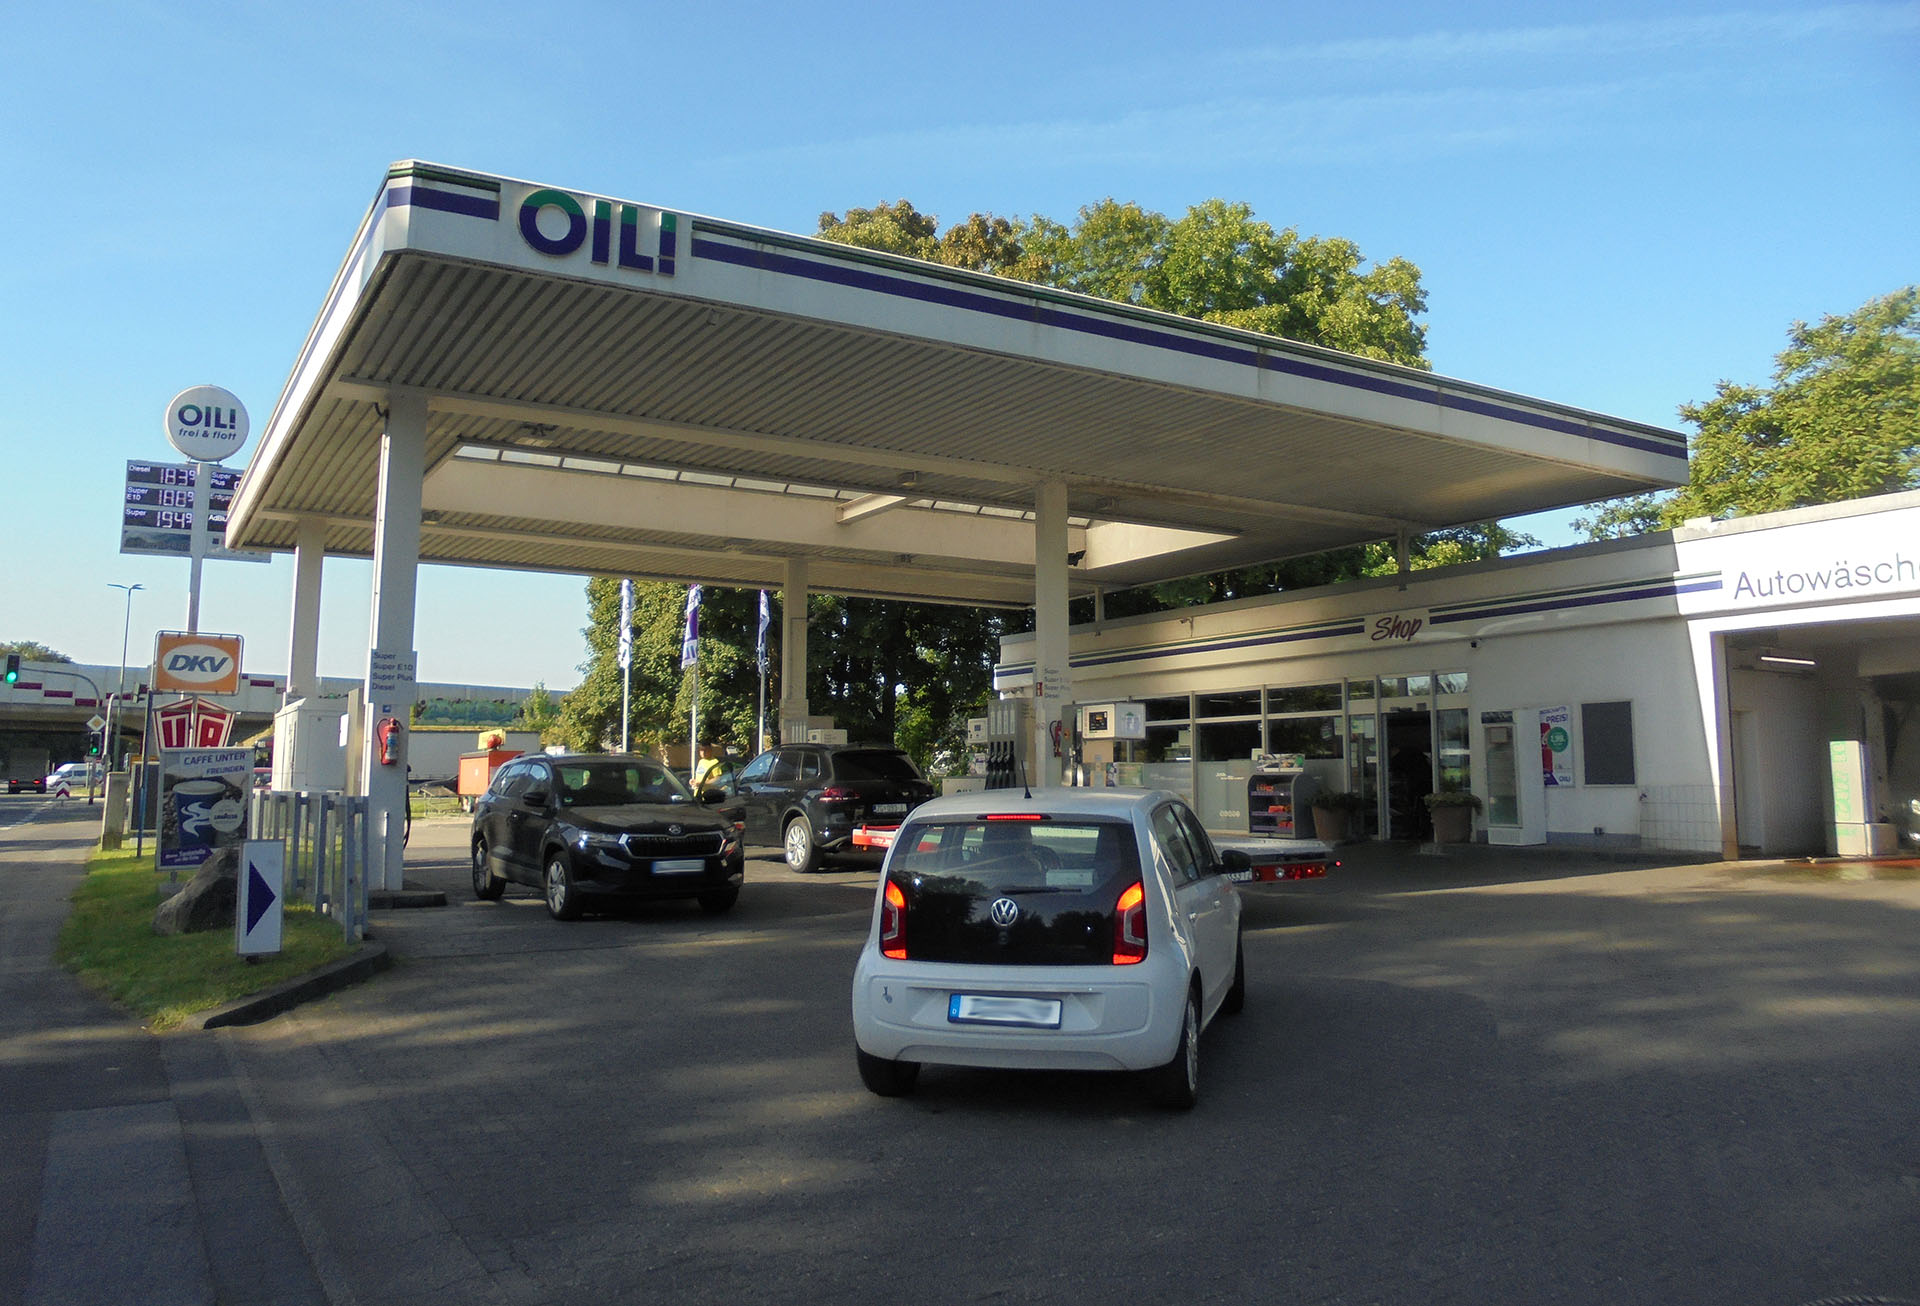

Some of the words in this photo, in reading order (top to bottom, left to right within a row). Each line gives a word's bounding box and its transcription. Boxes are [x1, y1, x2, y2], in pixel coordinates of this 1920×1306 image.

[519, 189, 677, 276] OIL!
[178, 404, 236, 430] OIL!
[179, 428, 199, 438] frei
[202, 430, 209, 438] &
[213, 431, 236, 441] flott
[128, 464, 151, 473] Diesel
[211, 471, 232, 480] Super
[210, 478, 226, 486] Plus
[127, 486, 149, 495] Super
[125, 508, 147, 517] Super
[1734, 552, 1920, 600] Autowäsch
[1371, 615, 1423, 641] Shop
[374, 651, 397, 660] Super
[167, 654, 229, 673] DKV
[373, 662, 396, 671] Super
[397, 663, 414, 671] E10
[373, 672, 395, 681] Super
[397, 673, 414, 681] Plus
[372, 682, 395, 690] Diesel
[215, 751, 246, 762] UNTER
[206, 765, 245, 775] FREUNDEN
